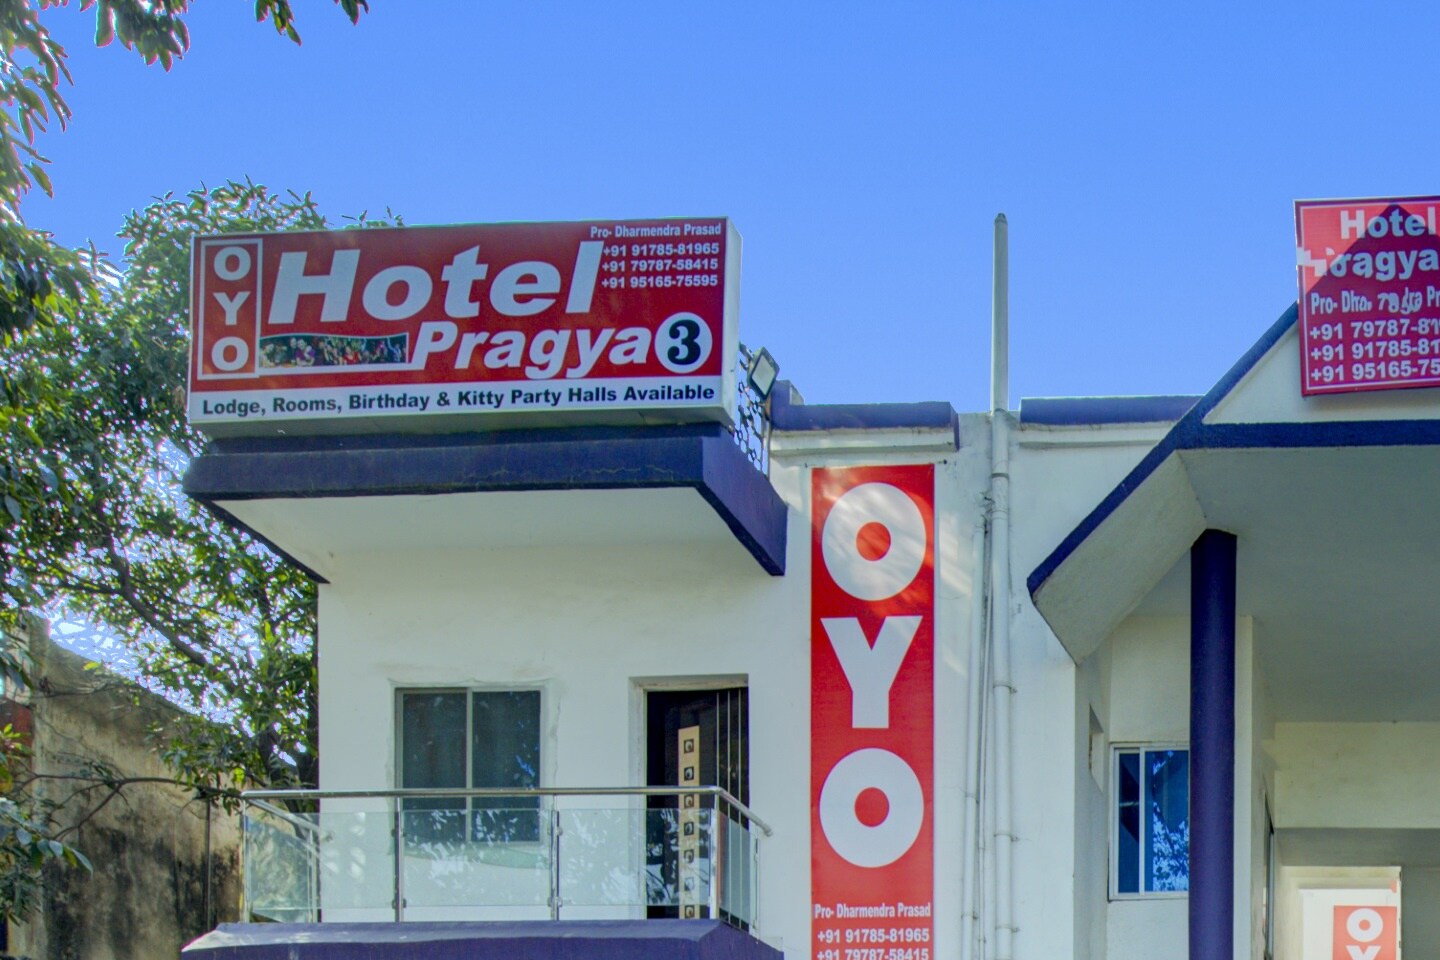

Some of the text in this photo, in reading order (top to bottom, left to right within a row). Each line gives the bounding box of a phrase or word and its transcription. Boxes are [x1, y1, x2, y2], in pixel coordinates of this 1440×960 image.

[590, 223, 721, 238] Pro- Dharmendra Prasad
[1340, 206, 1436, 240] Hotel
[603, 243, 719, 257] +91 91785-81965
[602, 258, 718, 272] +91 79787-58415
[267, 241, 604, 325] Hotel
[602, 274, 718, 289] +91 95165-75595
[211, 246, 252, 372] OYO
[1311, 292, 1337, 315] Pro-
[1310, 323, 1343, 340] +91
[408, 319, 701, 380] Pragya 3
[1311, 344, 1344, 362] +91
[1311, 364, 1344, 383] +91
[203, 384, 715, 417] Lodge, Rooms, Birthday & Kitty Party Halls Available
[819, 481, 927, 868] OYO
[814, 902, 931, 918] Pro- Dharmendra Prasad
[817, 928, 929, 943] +91 91785-81965
